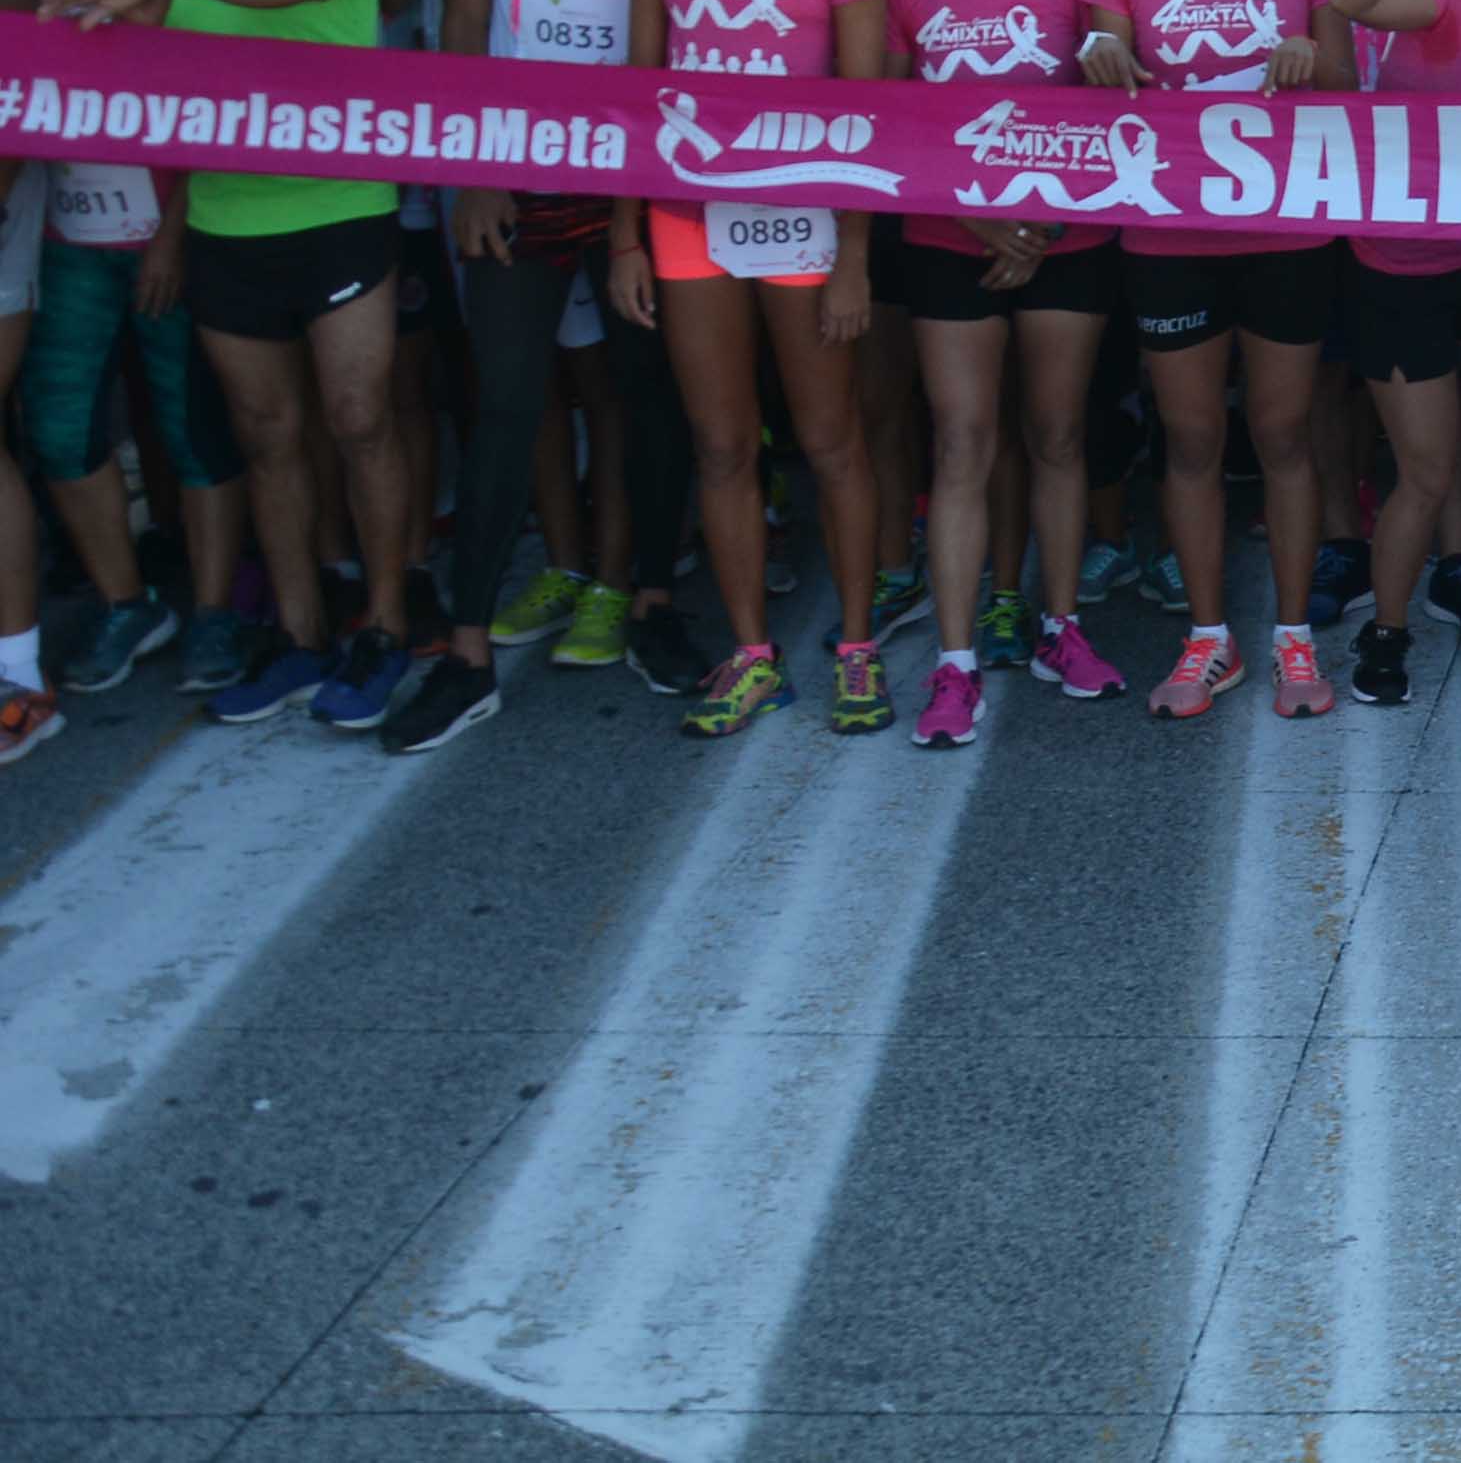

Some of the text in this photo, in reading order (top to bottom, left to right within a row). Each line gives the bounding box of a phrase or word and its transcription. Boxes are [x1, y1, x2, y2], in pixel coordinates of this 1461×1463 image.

[1180, 7, 1249, 24] MIXTA
[535, 18, 615, 50] 0833
[941, 22, 1008, 44] MIXTA
[0, 78, 627, 170] #ApoyarlasEsLaMeta
[730, 111, 874, 154] ADO
[1004, 130, 1109, 160] MIXTA
[56, 189, 129, 216] 0811
[729, 217, 813, 246] 0889
